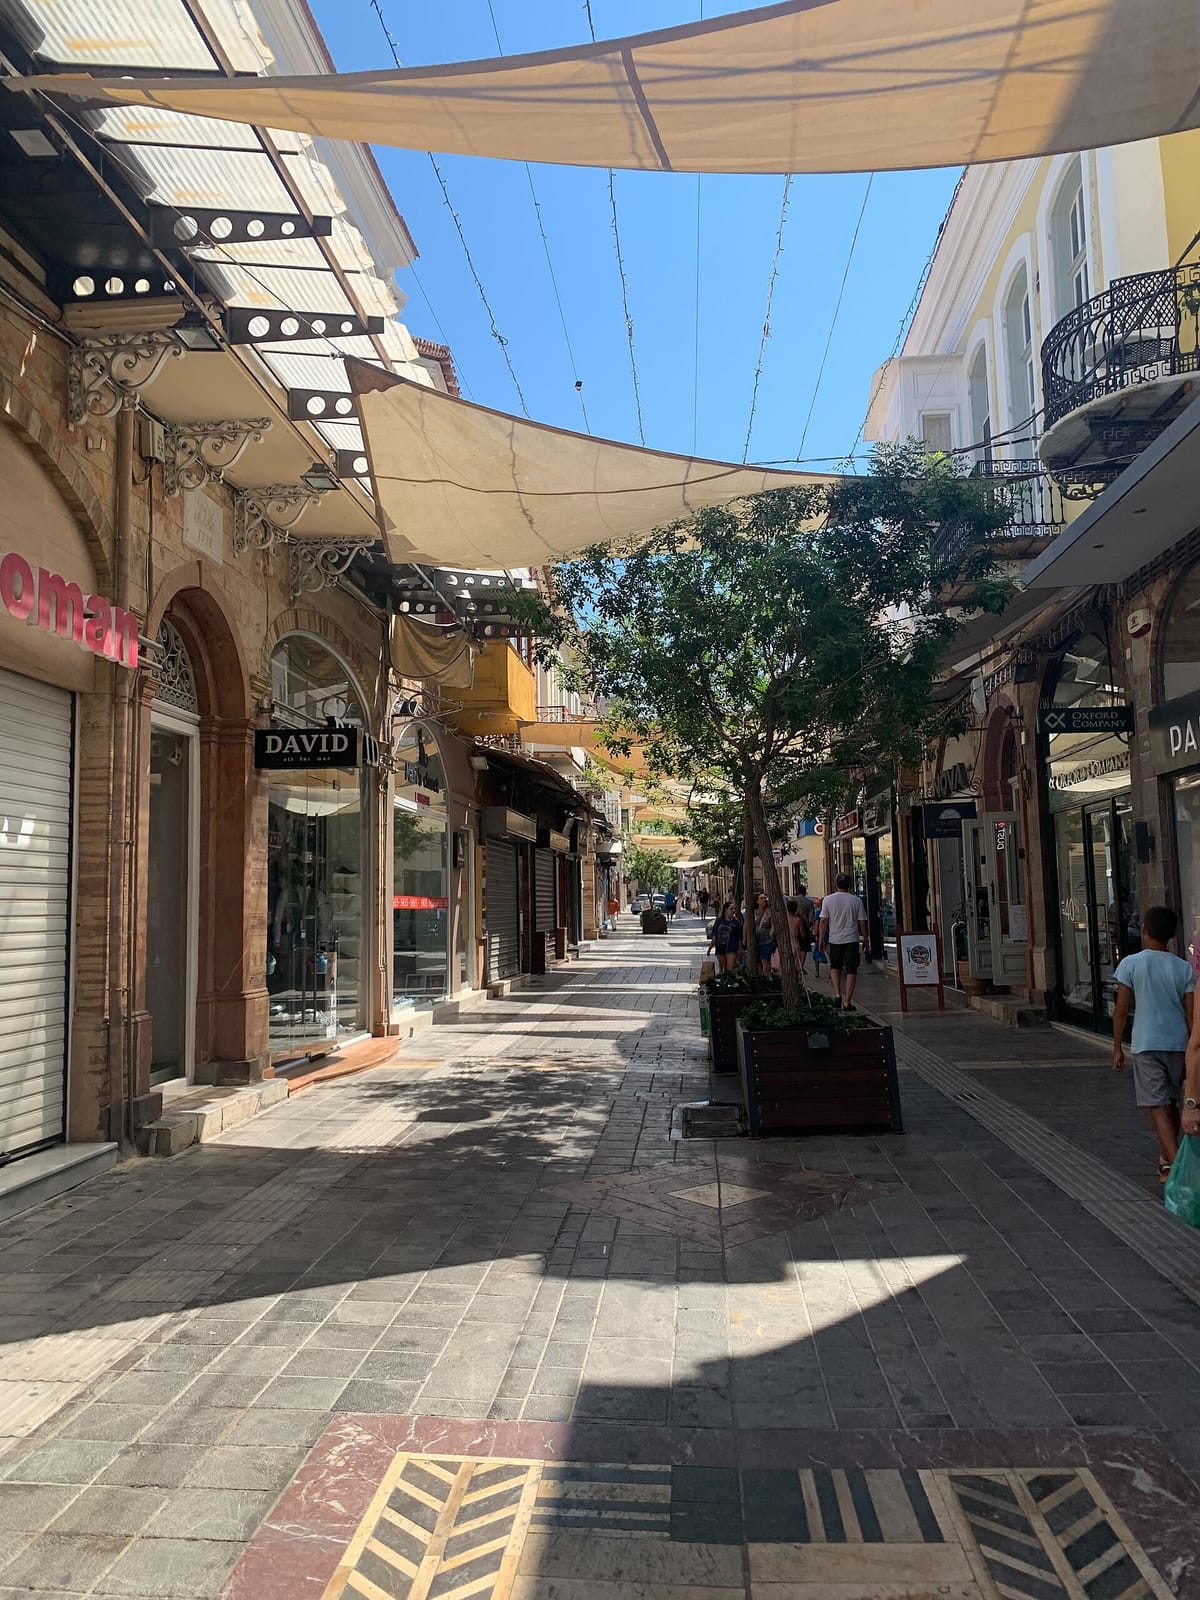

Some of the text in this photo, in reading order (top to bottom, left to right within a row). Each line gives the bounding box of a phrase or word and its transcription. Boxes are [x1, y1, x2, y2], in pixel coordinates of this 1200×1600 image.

[0, 552, 138, 669] oman
[1072, 711, 1119, 720] OXFORD
[1072, 720, 1126, 728] COMPANY
[265, 733, 349, 754] DAVID
[1169, 716, 1200, 757] PA
